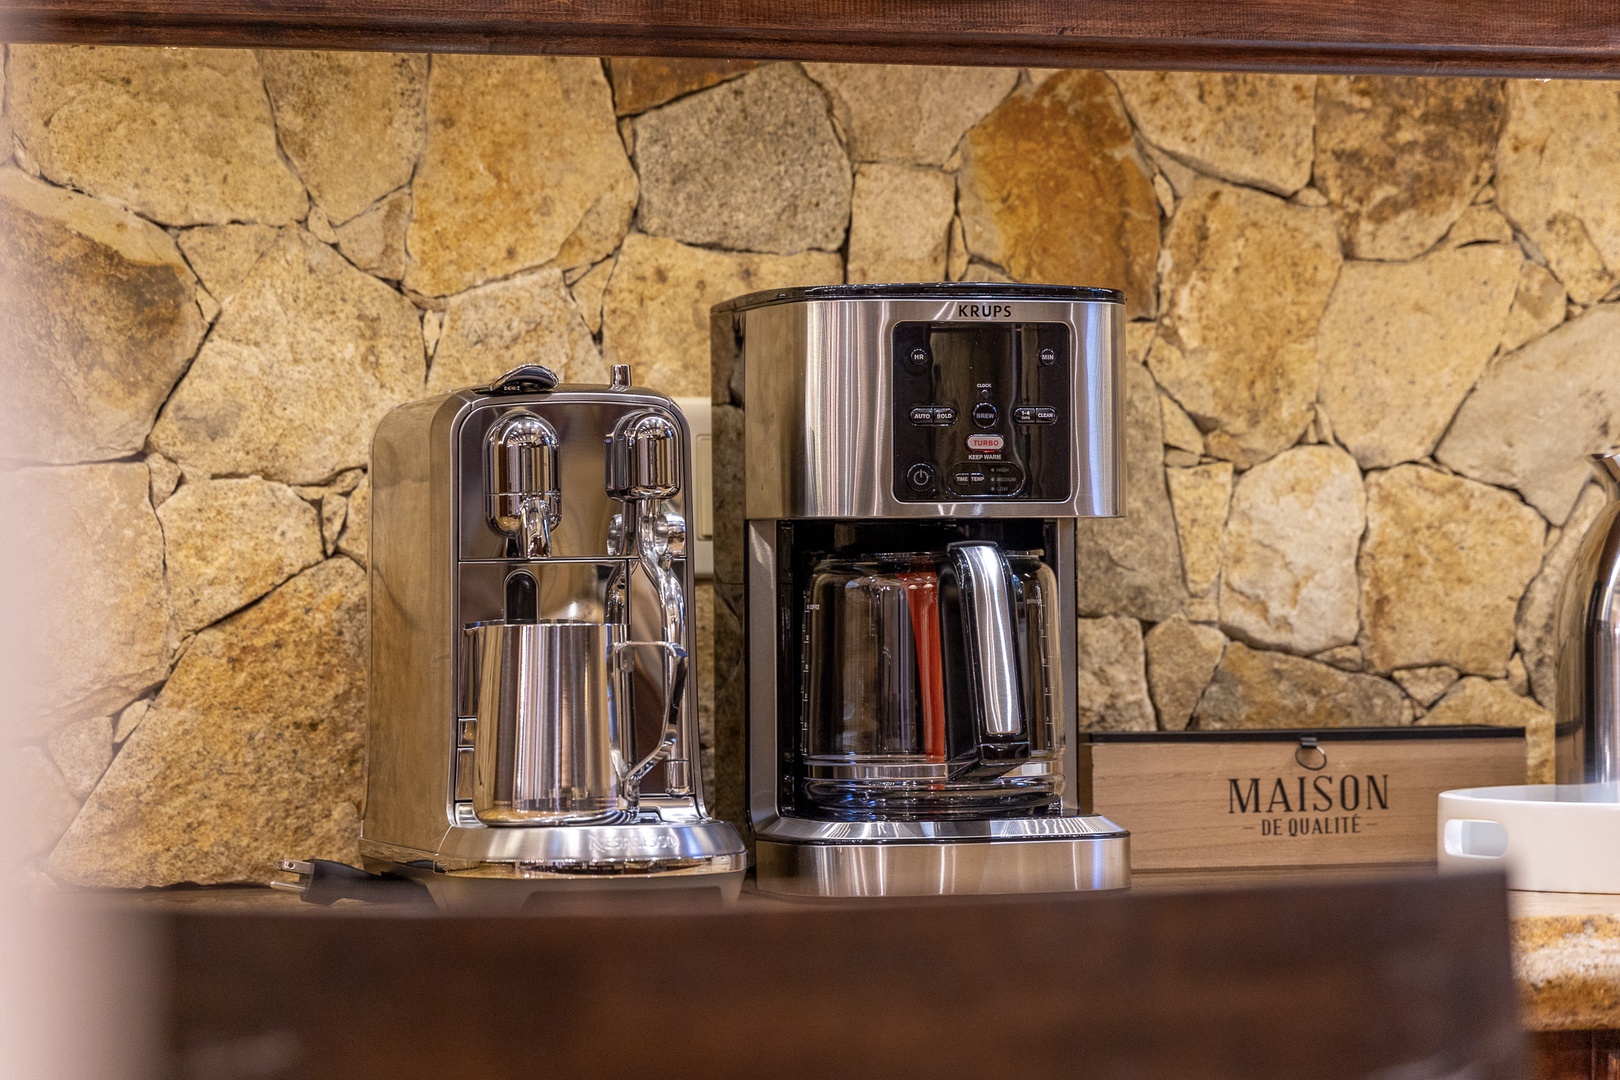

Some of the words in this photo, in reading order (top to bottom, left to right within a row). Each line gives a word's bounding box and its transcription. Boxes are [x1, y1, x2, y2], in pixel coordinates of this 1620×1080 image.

[958, 305, 1012, 317] KRUPS
[1228, 774, 1389, 814] MAISON
[1261, 819, 1283, 836] DE
[1288, 814, 1361, 837] QUALITÉ
